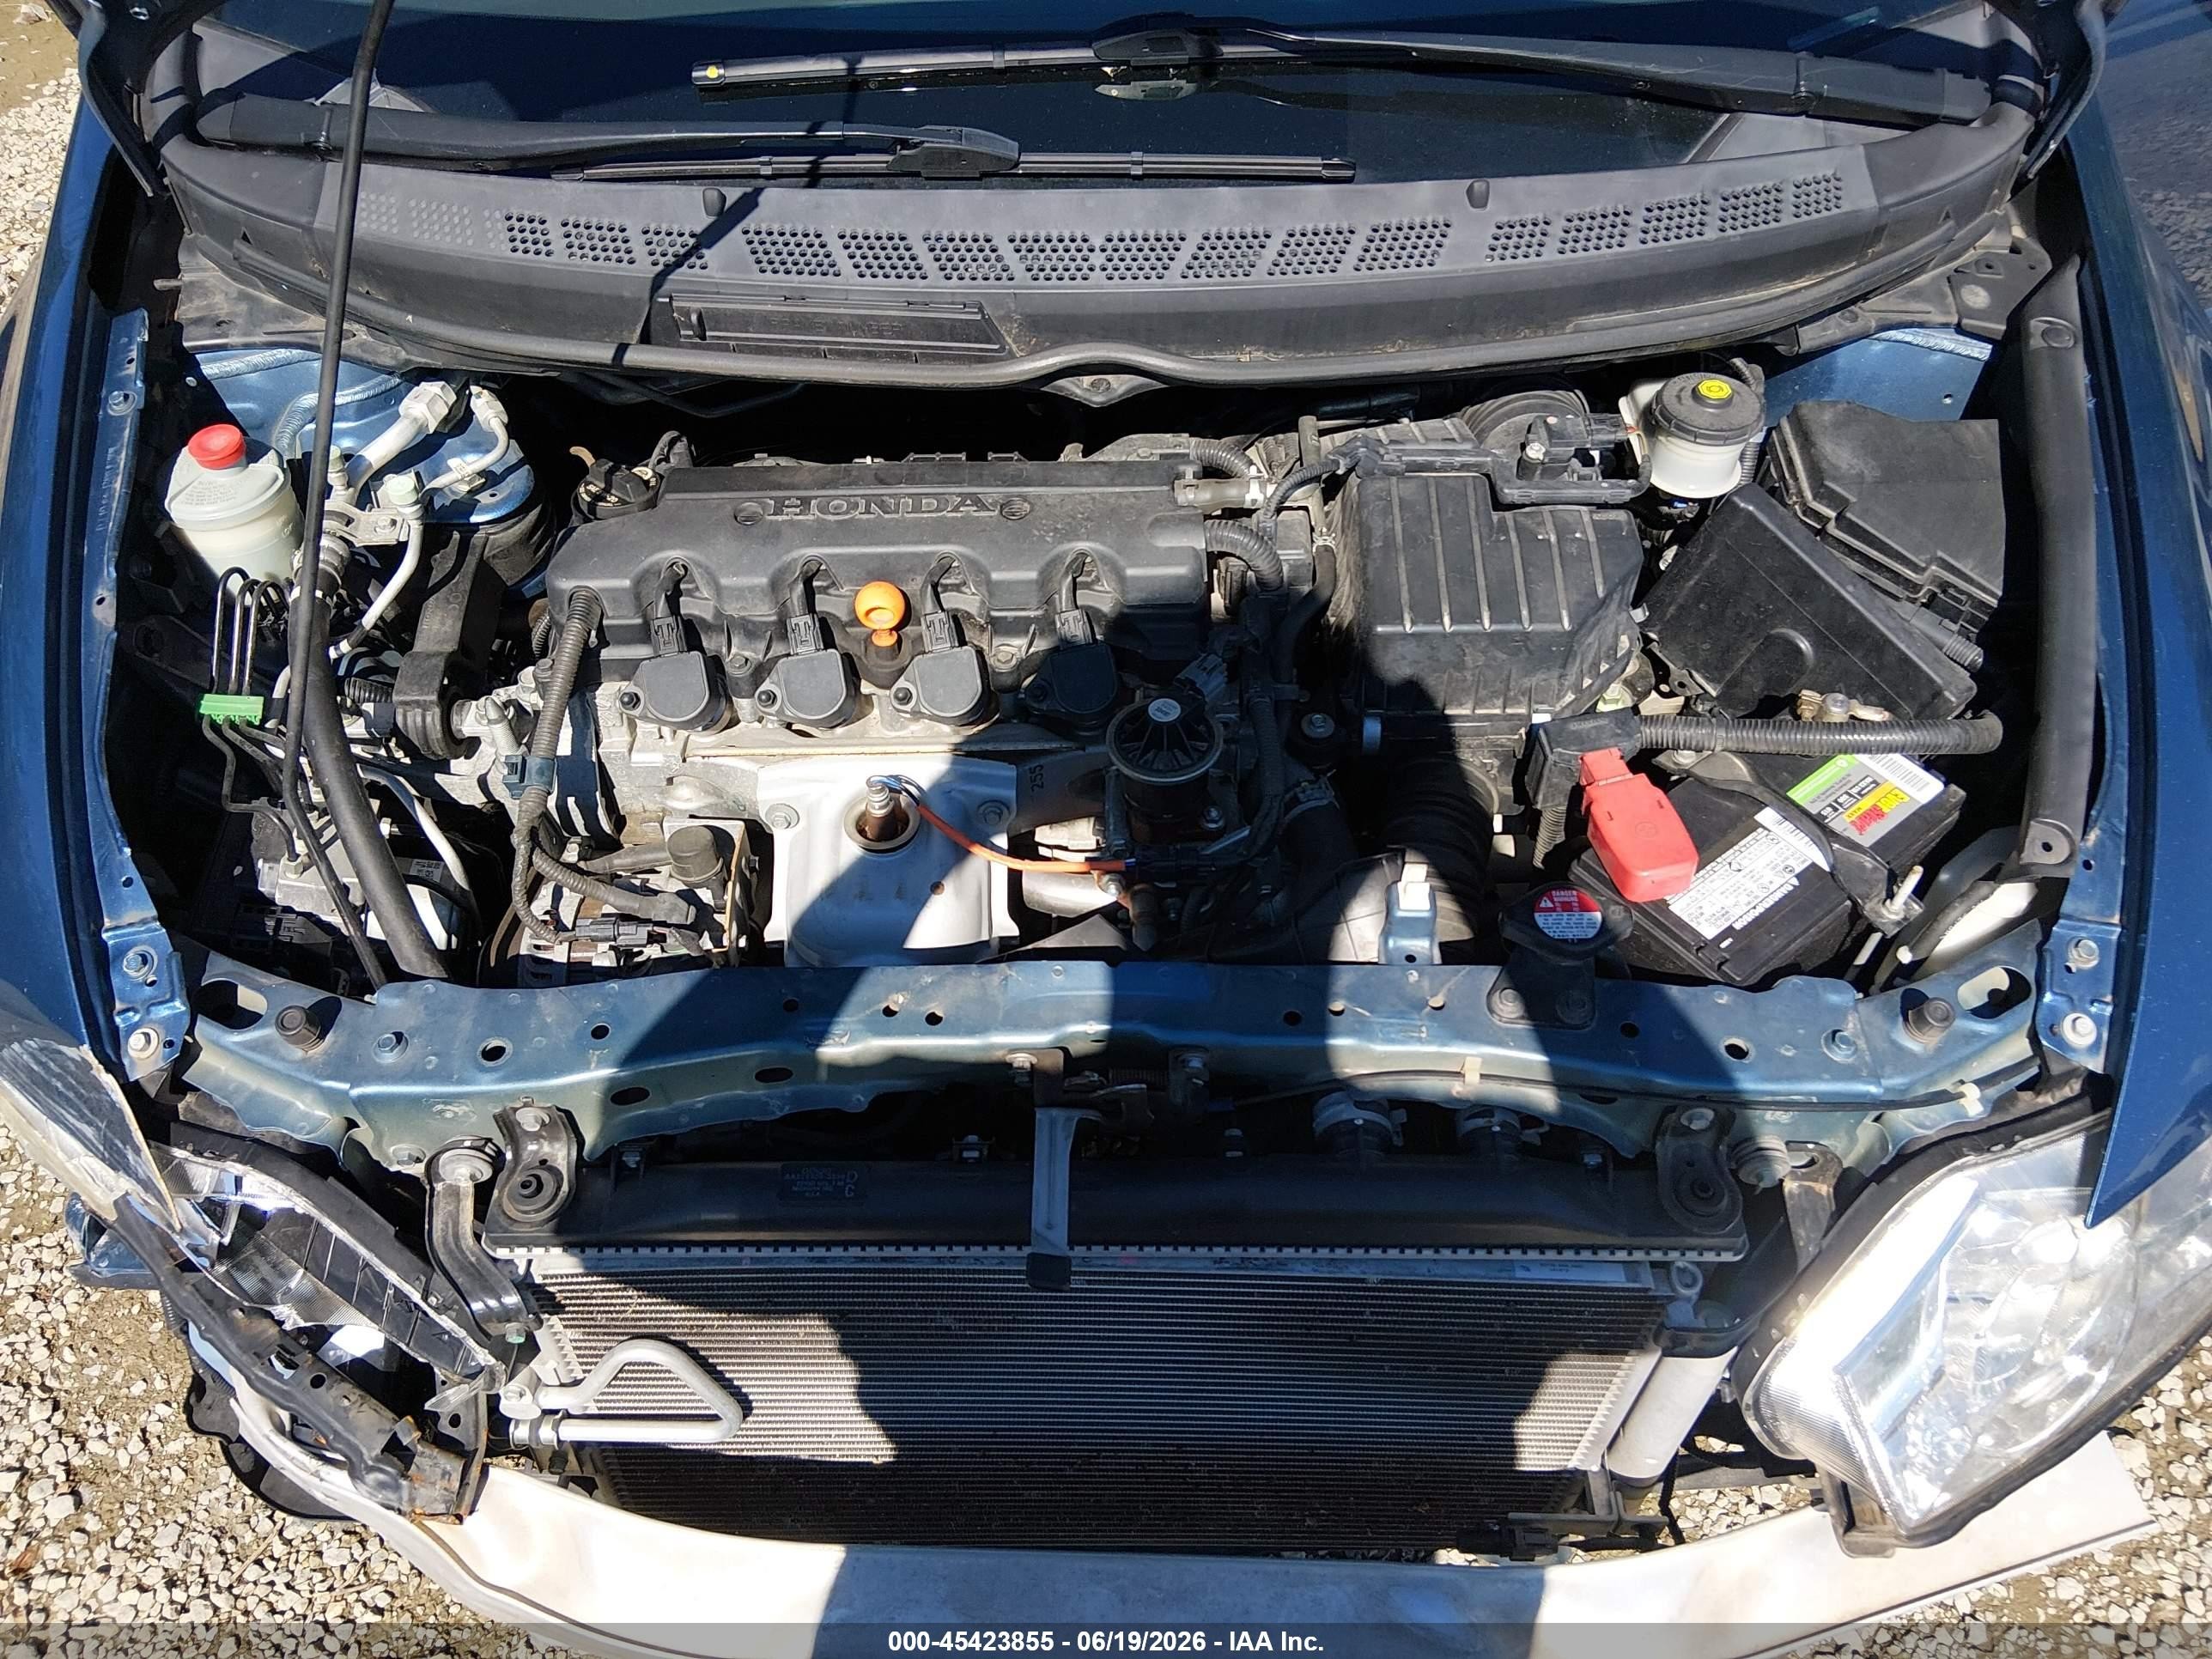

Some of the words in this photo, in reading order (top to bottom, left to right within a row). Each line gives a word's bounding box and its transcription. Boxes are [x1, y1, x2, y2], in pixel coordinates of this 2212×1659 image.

[767, 494, 998, 520] HONDA
[1029, 764, 1044, 792] 255
[1849, 787, 1911, 833] EverStart
